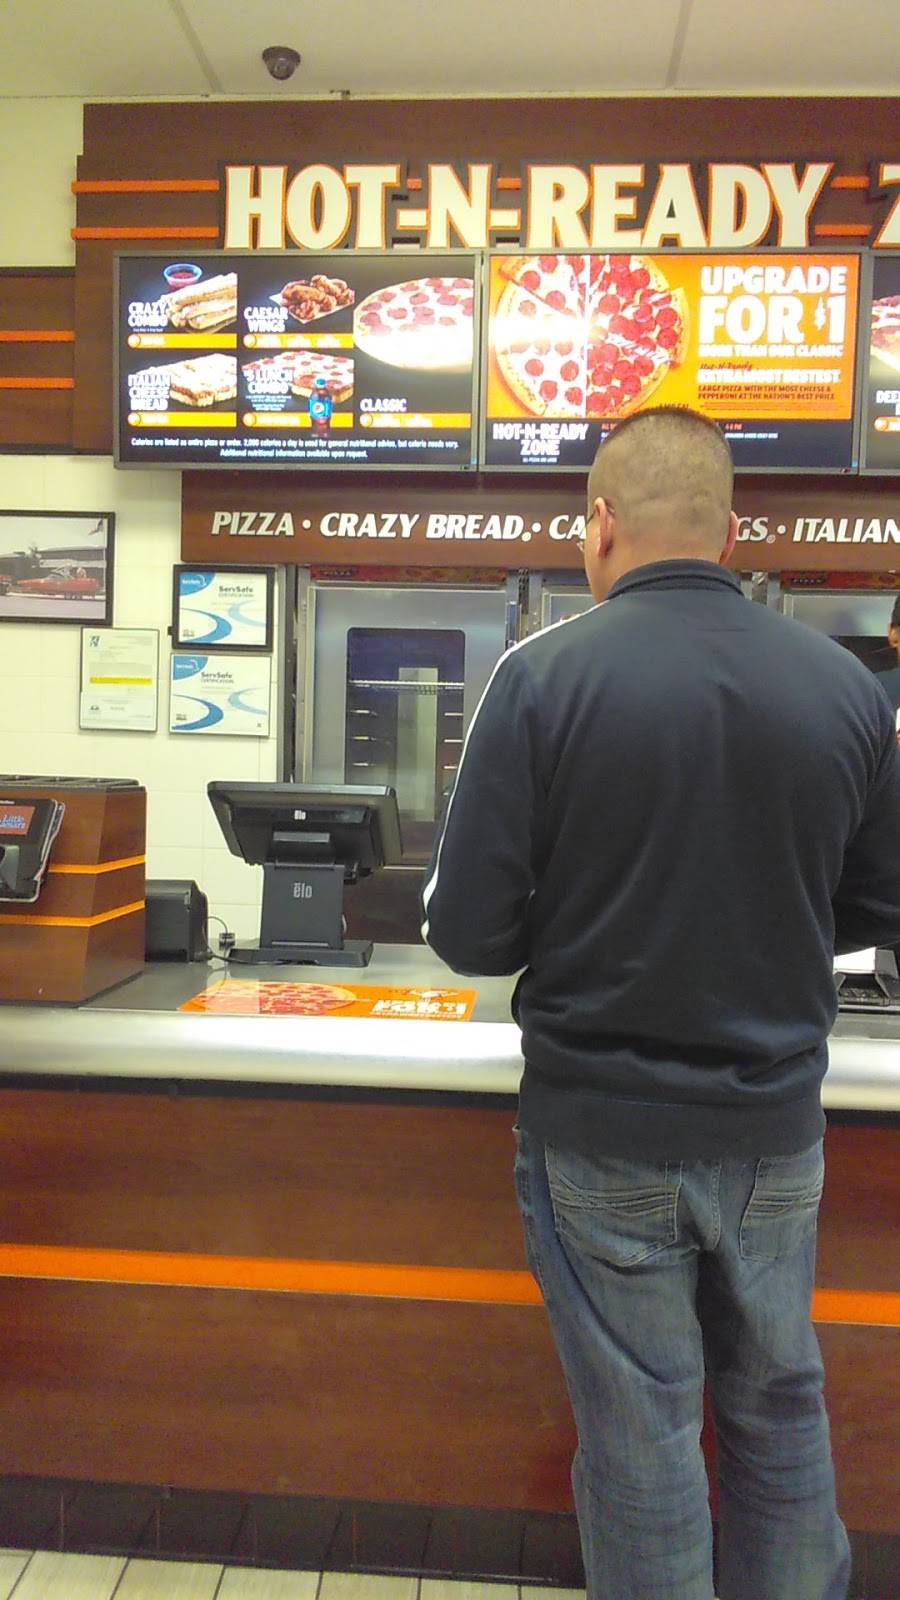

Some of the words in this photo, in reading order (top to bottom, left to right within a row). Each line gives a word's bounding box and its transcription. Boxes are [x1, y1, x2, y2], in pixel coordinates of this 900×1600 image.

[224, 163, 834, 249] HOT-N-READY
[700, 265, 847, 294] UPGRADE
[128, 302, 167, 314] CRAZY
[243, 306, 288, 320] CAESAR
[699, 294, 804, 344] FOR
[247, 320, 286, 332] WINGS
[795, 345, 843, 357] CLASSIC
[128, 374, 171, 387] ITALIAN
[799, 385, 824, 393] CHEESE
[698, 392, 738, 400] PEPPERONI
[360, 398, 407, 412] CLASSIC
[492, 423, 589, 440] HOT-N-READY
[131, 438, 153, 446] Calories
[520, 440, 560, 455] ZONE
[220, 449, 247, 457] Additional
[211, 511, 295, 536] PIZZA
[319, 512, 419, 538] CRAZY
